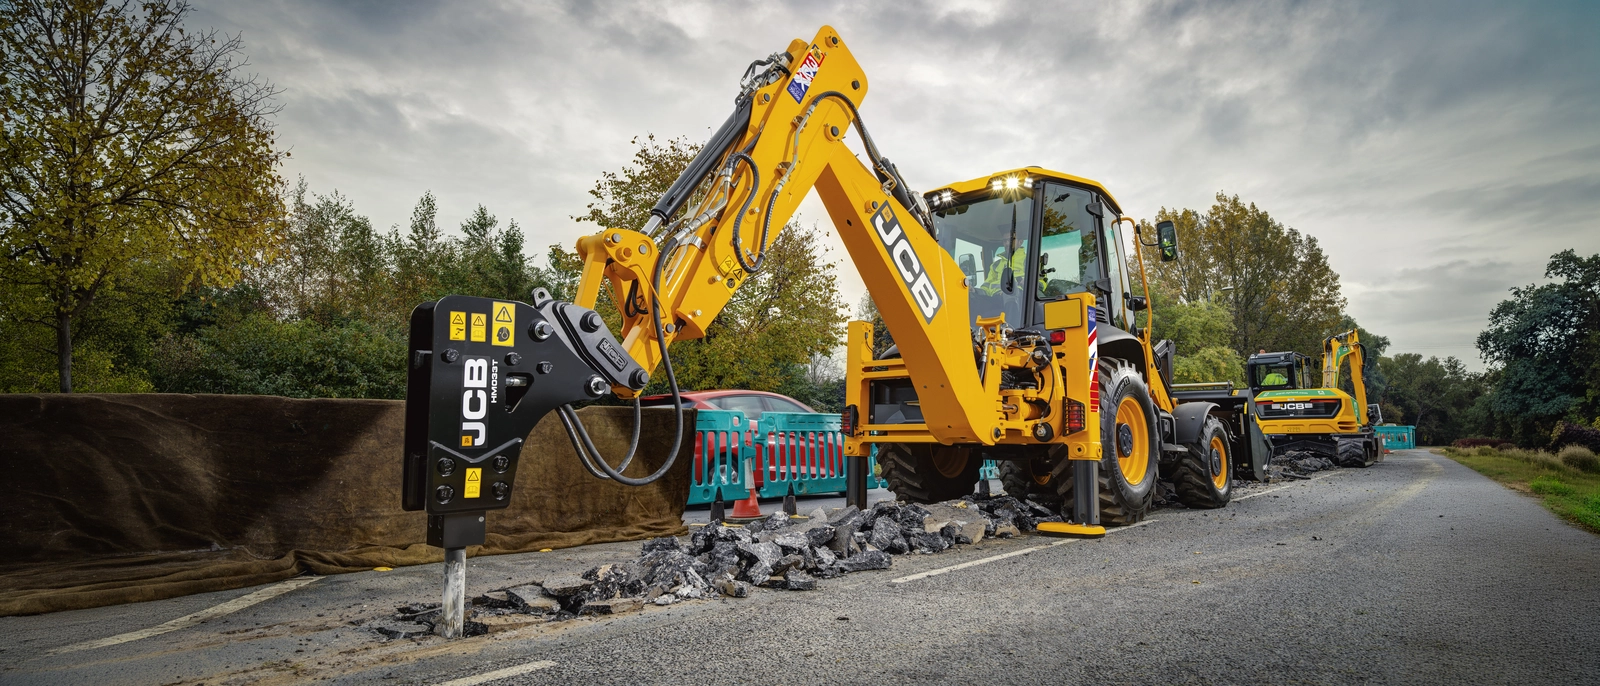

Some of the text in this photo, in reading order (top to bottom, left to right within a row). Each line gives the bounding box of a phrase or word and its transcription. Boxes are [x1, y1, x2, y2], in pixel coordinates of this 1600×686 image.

[875, 214, 939, 318] JCB
[491, 359, 499, 404] HM033T
[599, 339, 626, 367] JCB
[462, 358, 488, 446] JCB
